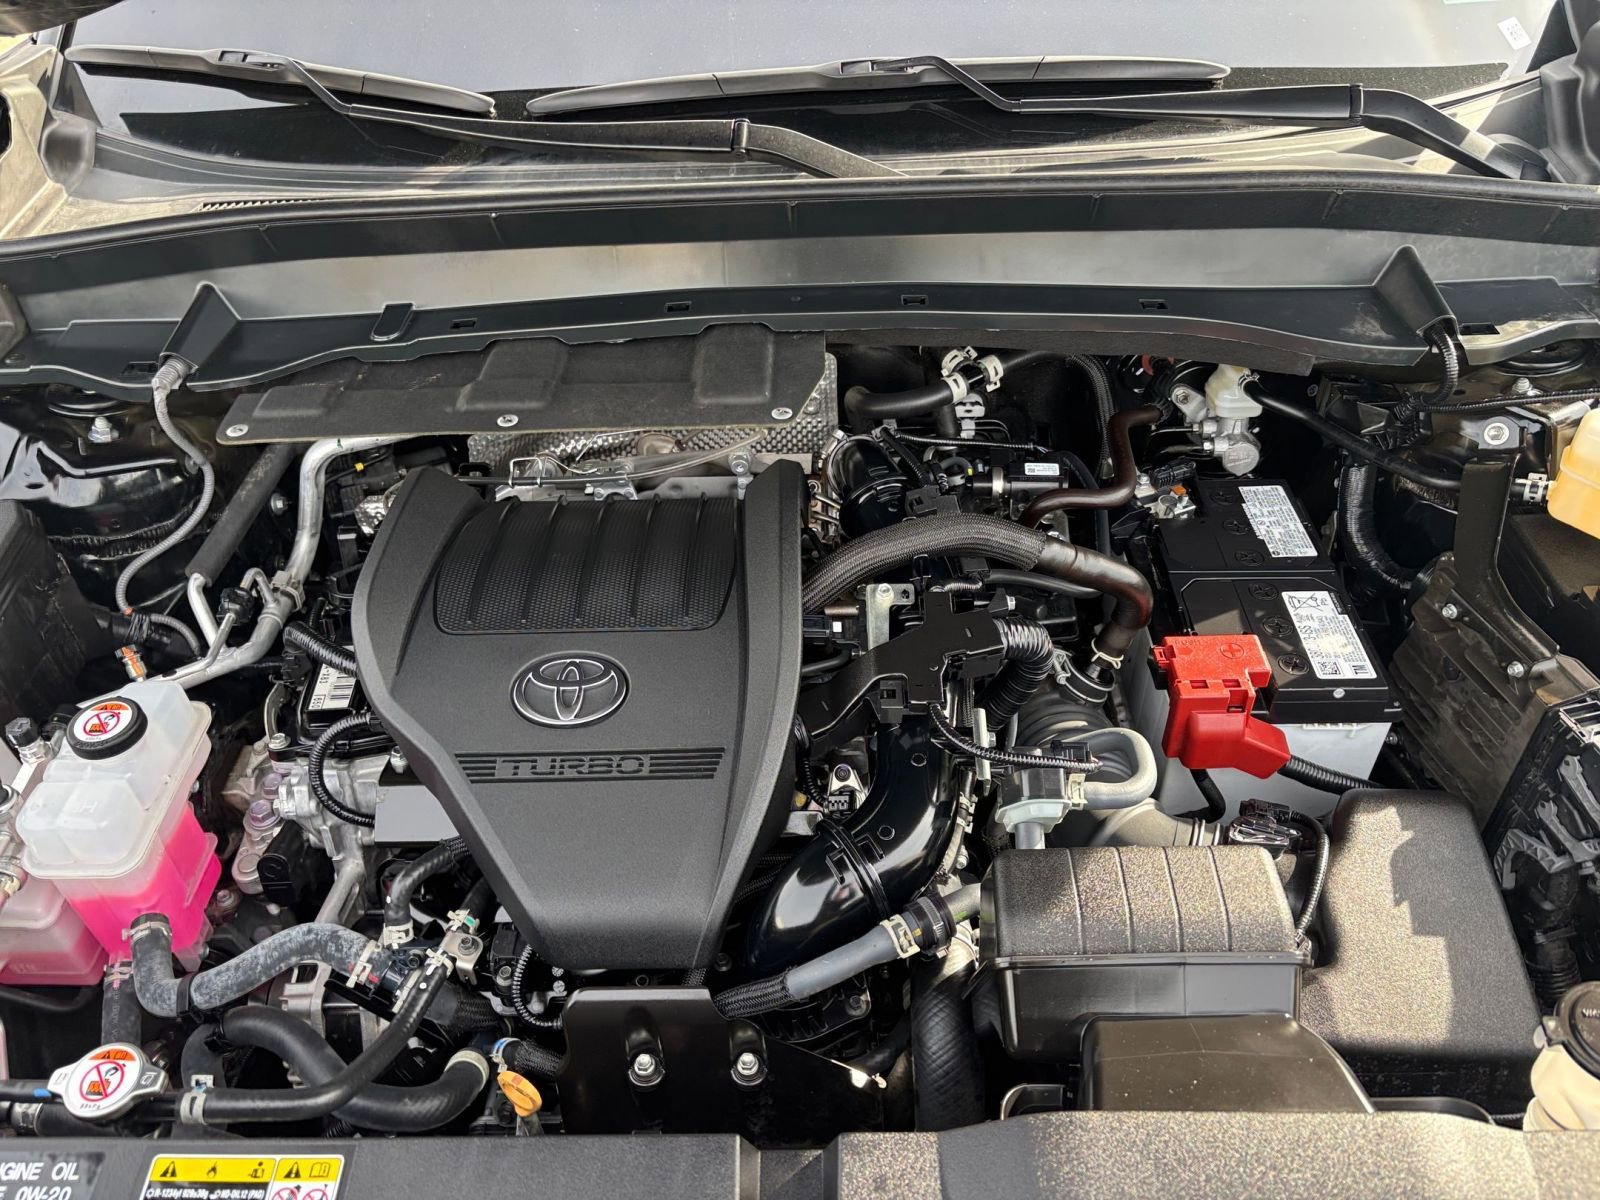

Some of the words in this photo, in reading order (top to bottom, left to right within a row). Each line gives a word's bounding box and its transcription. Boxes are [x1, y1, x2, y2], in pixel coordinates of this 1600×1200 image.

[501, 755, 645, 777] TURBO
[51, 1161, 80, 1180] OIL
[14, 1186, 72, 1200] 0W-20
